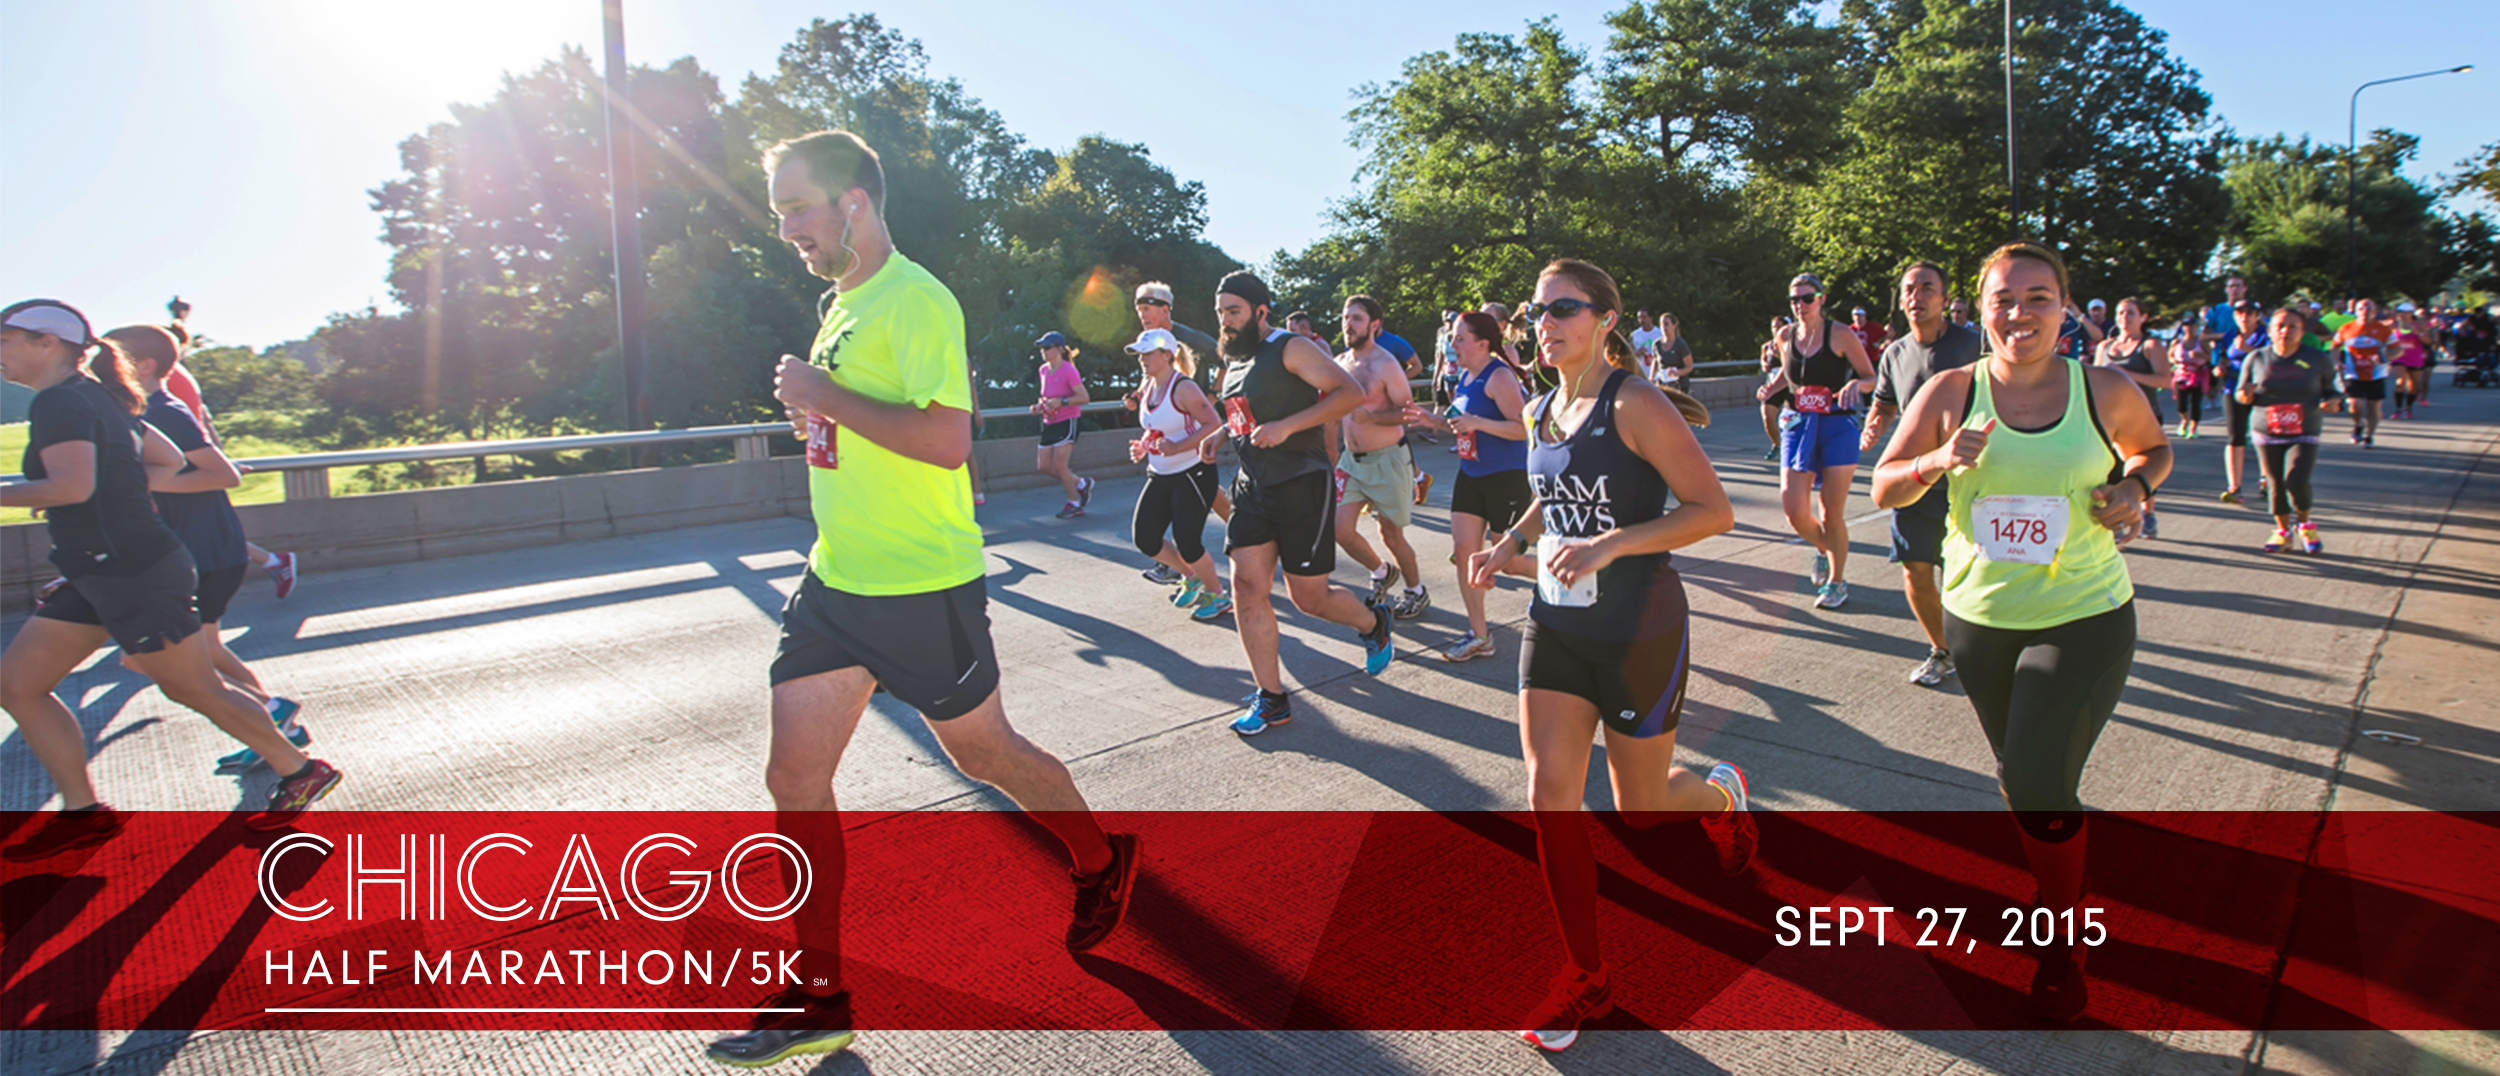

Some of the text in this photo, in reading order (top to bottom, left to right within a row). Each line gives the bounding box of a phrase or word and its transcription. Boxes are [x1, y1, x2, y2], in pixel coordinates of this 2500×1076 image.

[1799, 394, 1827, 407] 8075
[1529, 472, 1612, 504] EAM
[1990, 517, 2048, 545] 1478
[2006, 547, 2027, 556] ANA
